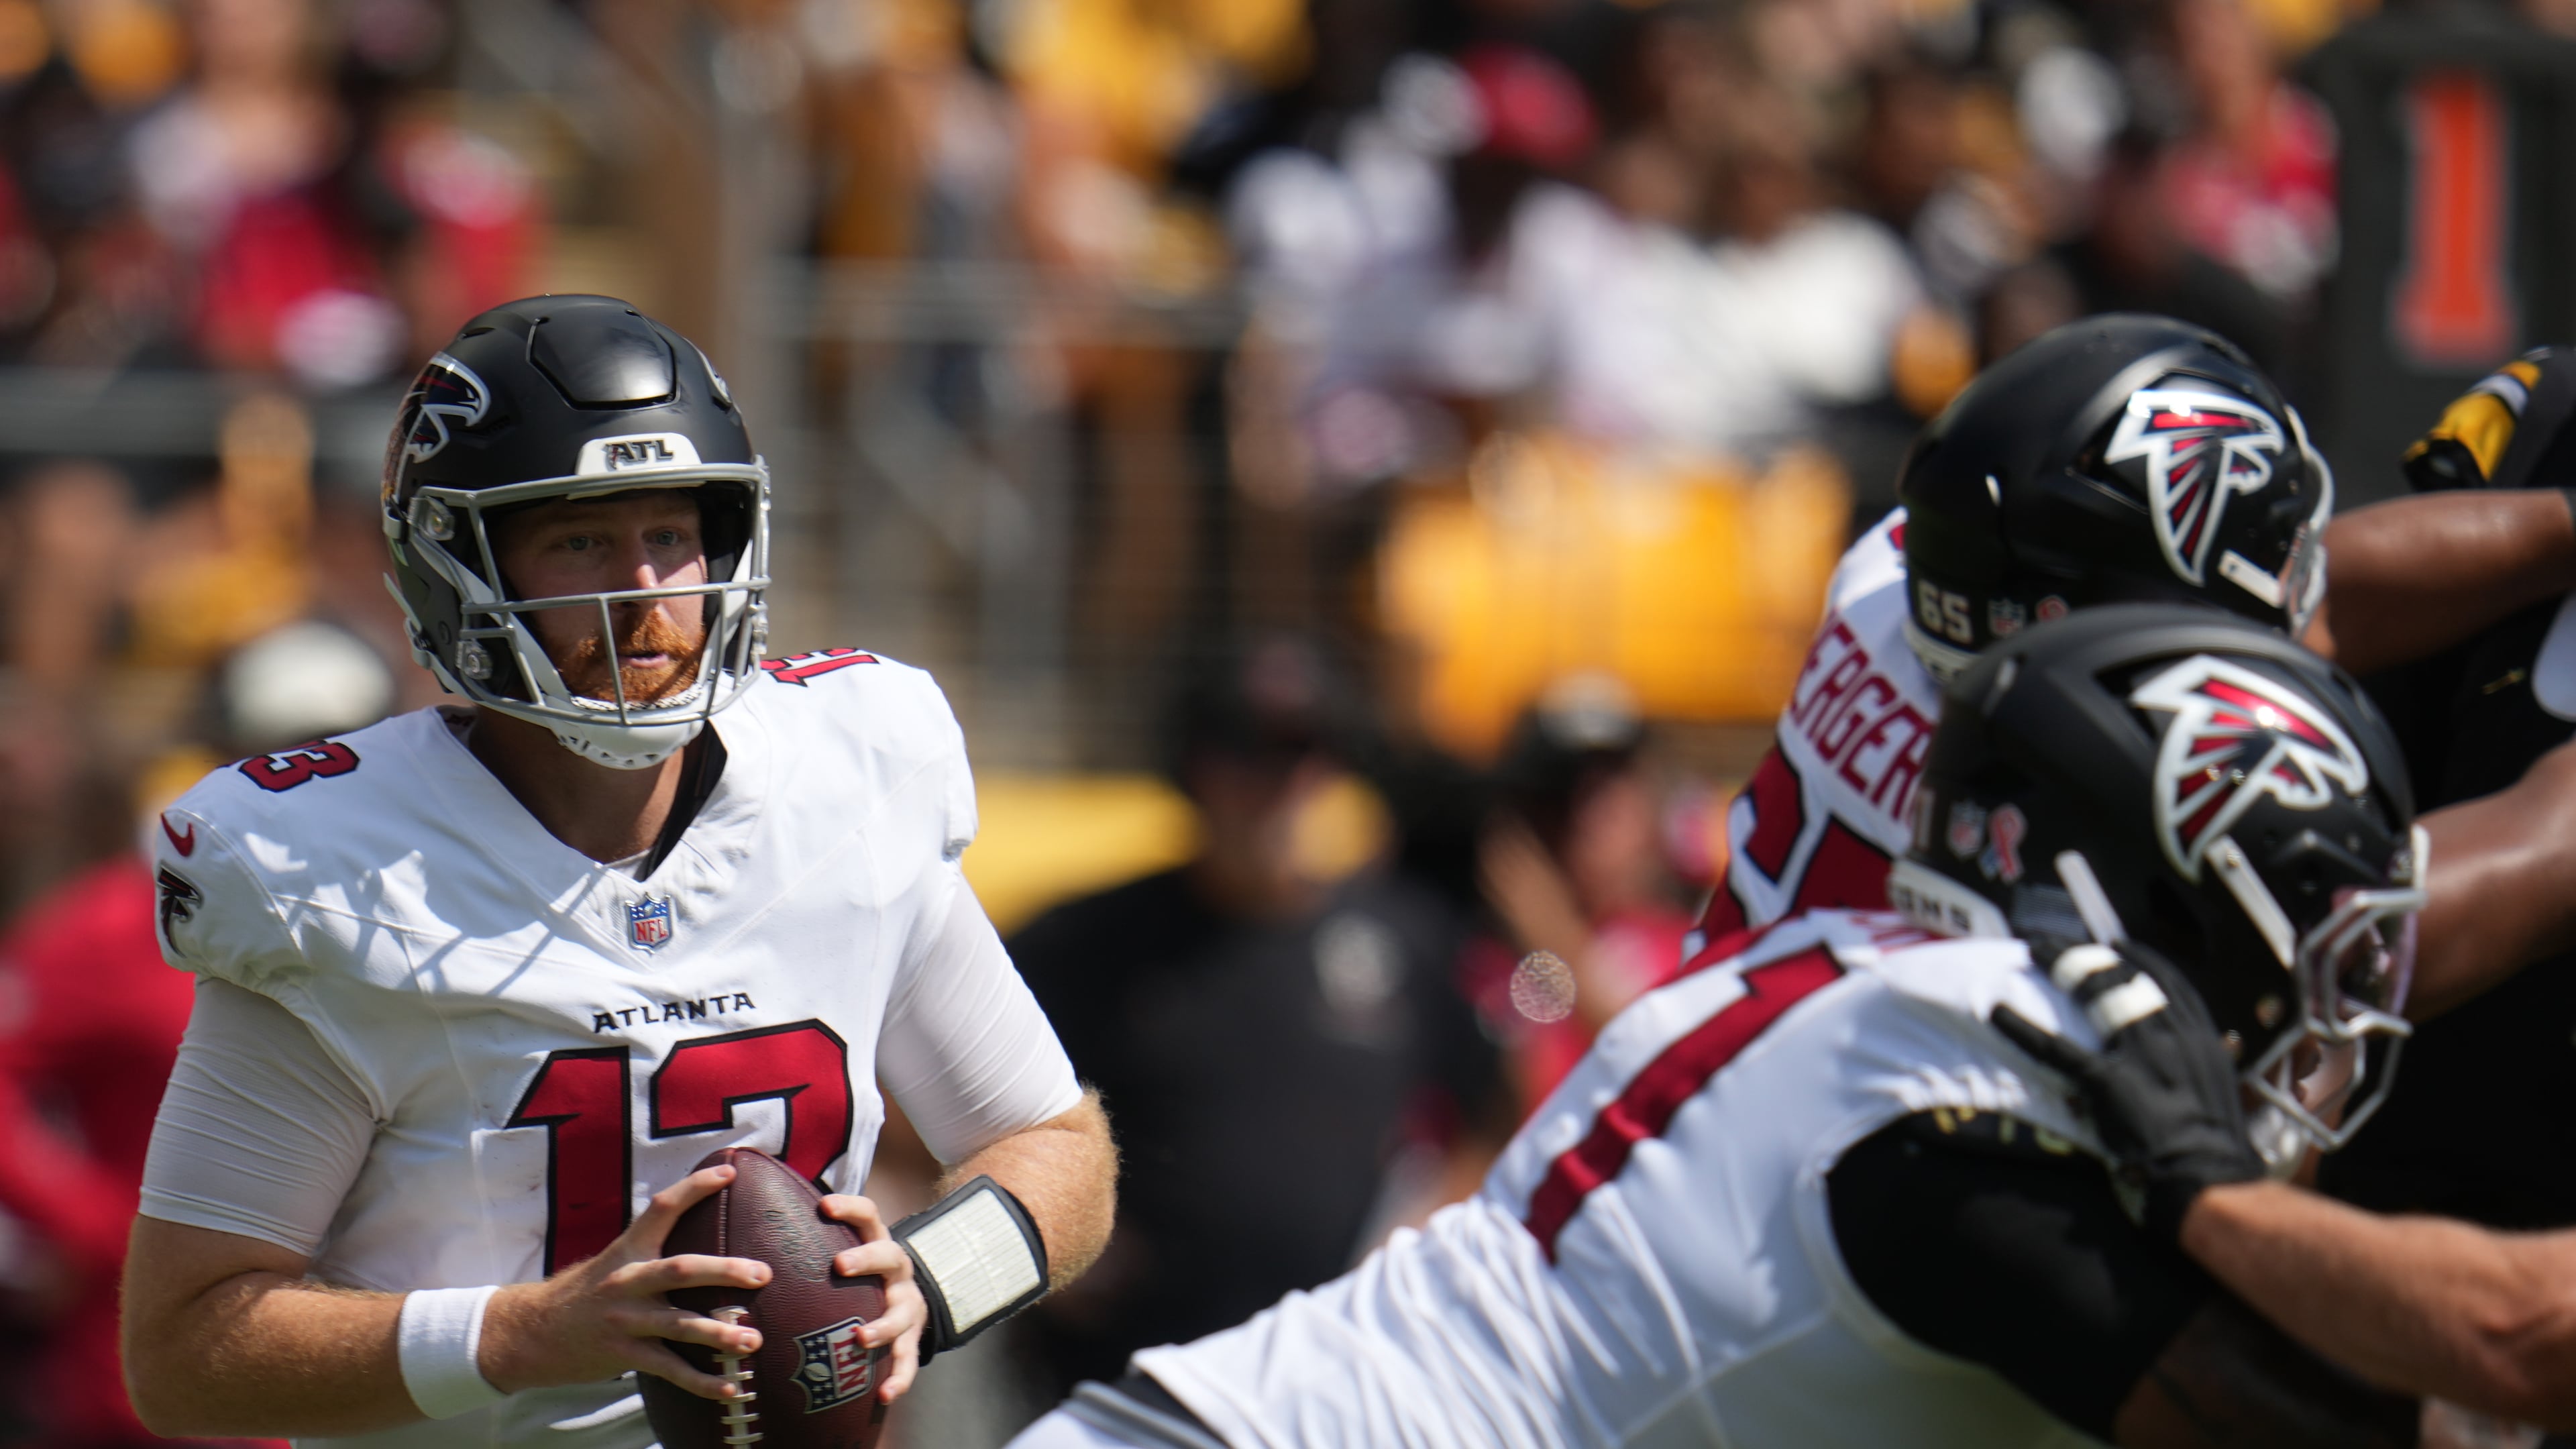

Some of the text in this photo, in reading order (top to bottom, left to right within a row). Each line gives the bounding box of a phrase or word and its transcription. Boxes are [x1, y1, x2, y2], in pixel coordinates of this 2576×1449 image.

[605, 439, 674, 470] ATL
[1917, 579, 1974, 645] 65
[237, 739, 361, 793] 3
[634, 918, 669, 943] NFL
[592, 992, 756, 1034] ATLANTA
